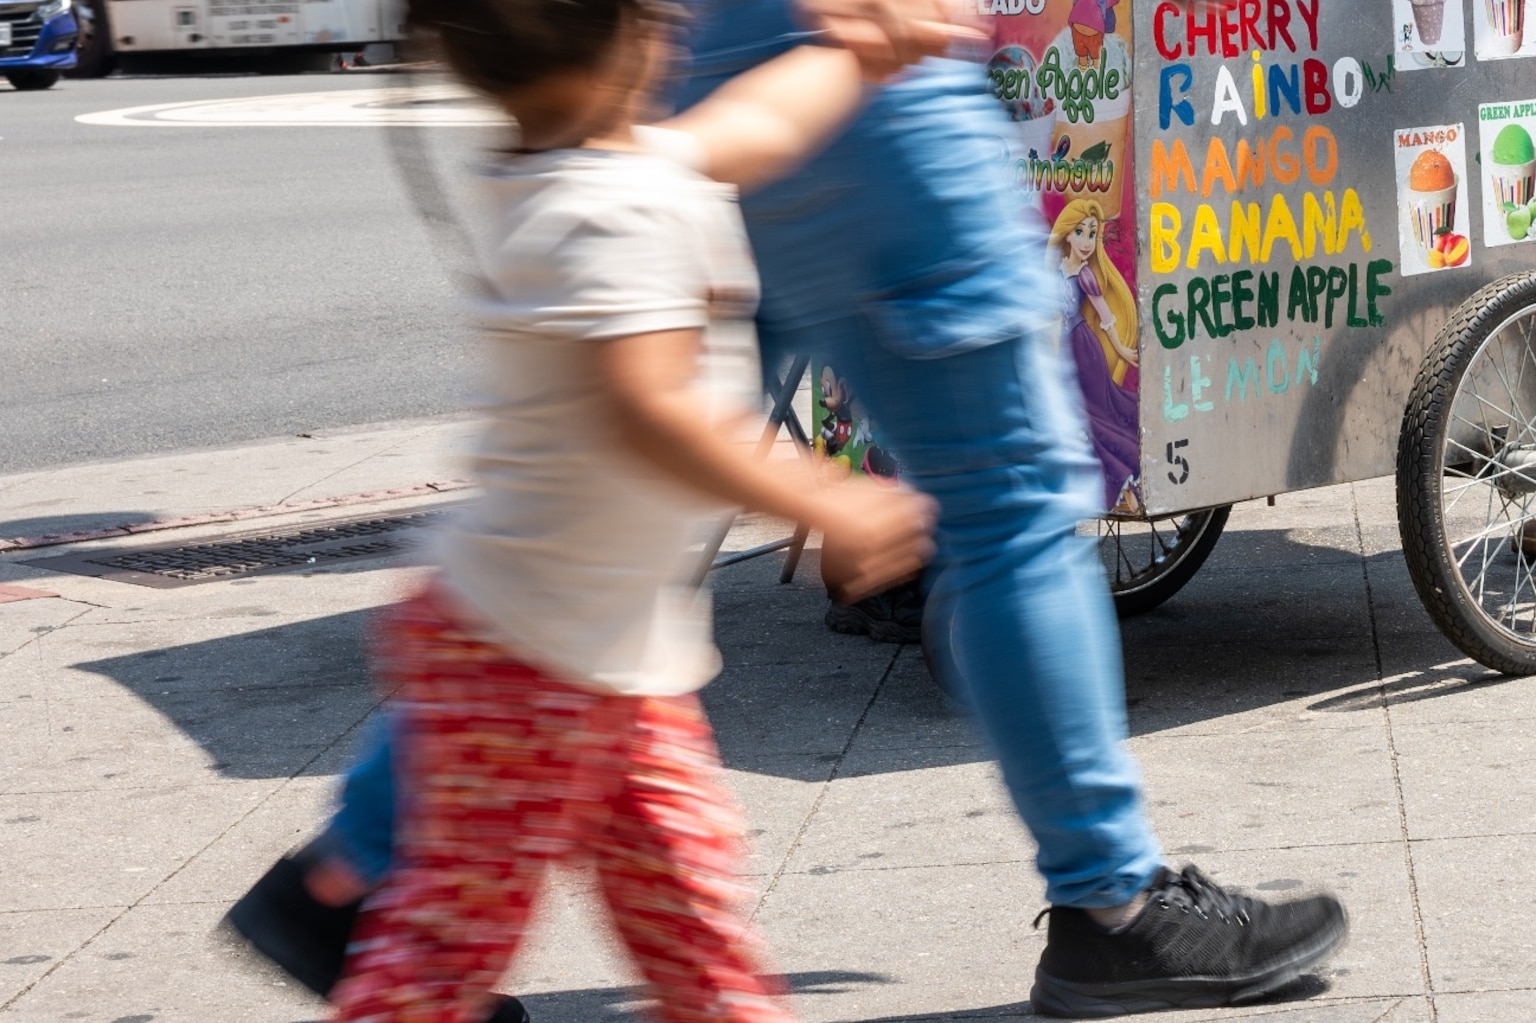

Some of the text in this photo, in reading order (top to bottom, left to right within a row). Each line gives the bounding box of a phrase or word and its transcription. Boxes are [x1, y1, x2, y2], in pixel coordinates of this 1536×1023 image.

[1037, 45, 1120, 124] Apple
[1480, 105, 1511, 121] GREEN
[1010, 134, 1115, 194] ainbow
[1150, 125, 1338, 201] MANGO
[1398, 129, 1458, 148] MANGO
[1150, 188, 1373, 274] BANANA
[1152, 258, 1394, 350] GREEN APPLE
[1163, 337, 1321, 423] LEMON
[1165, 438, 1190, 486] 5
